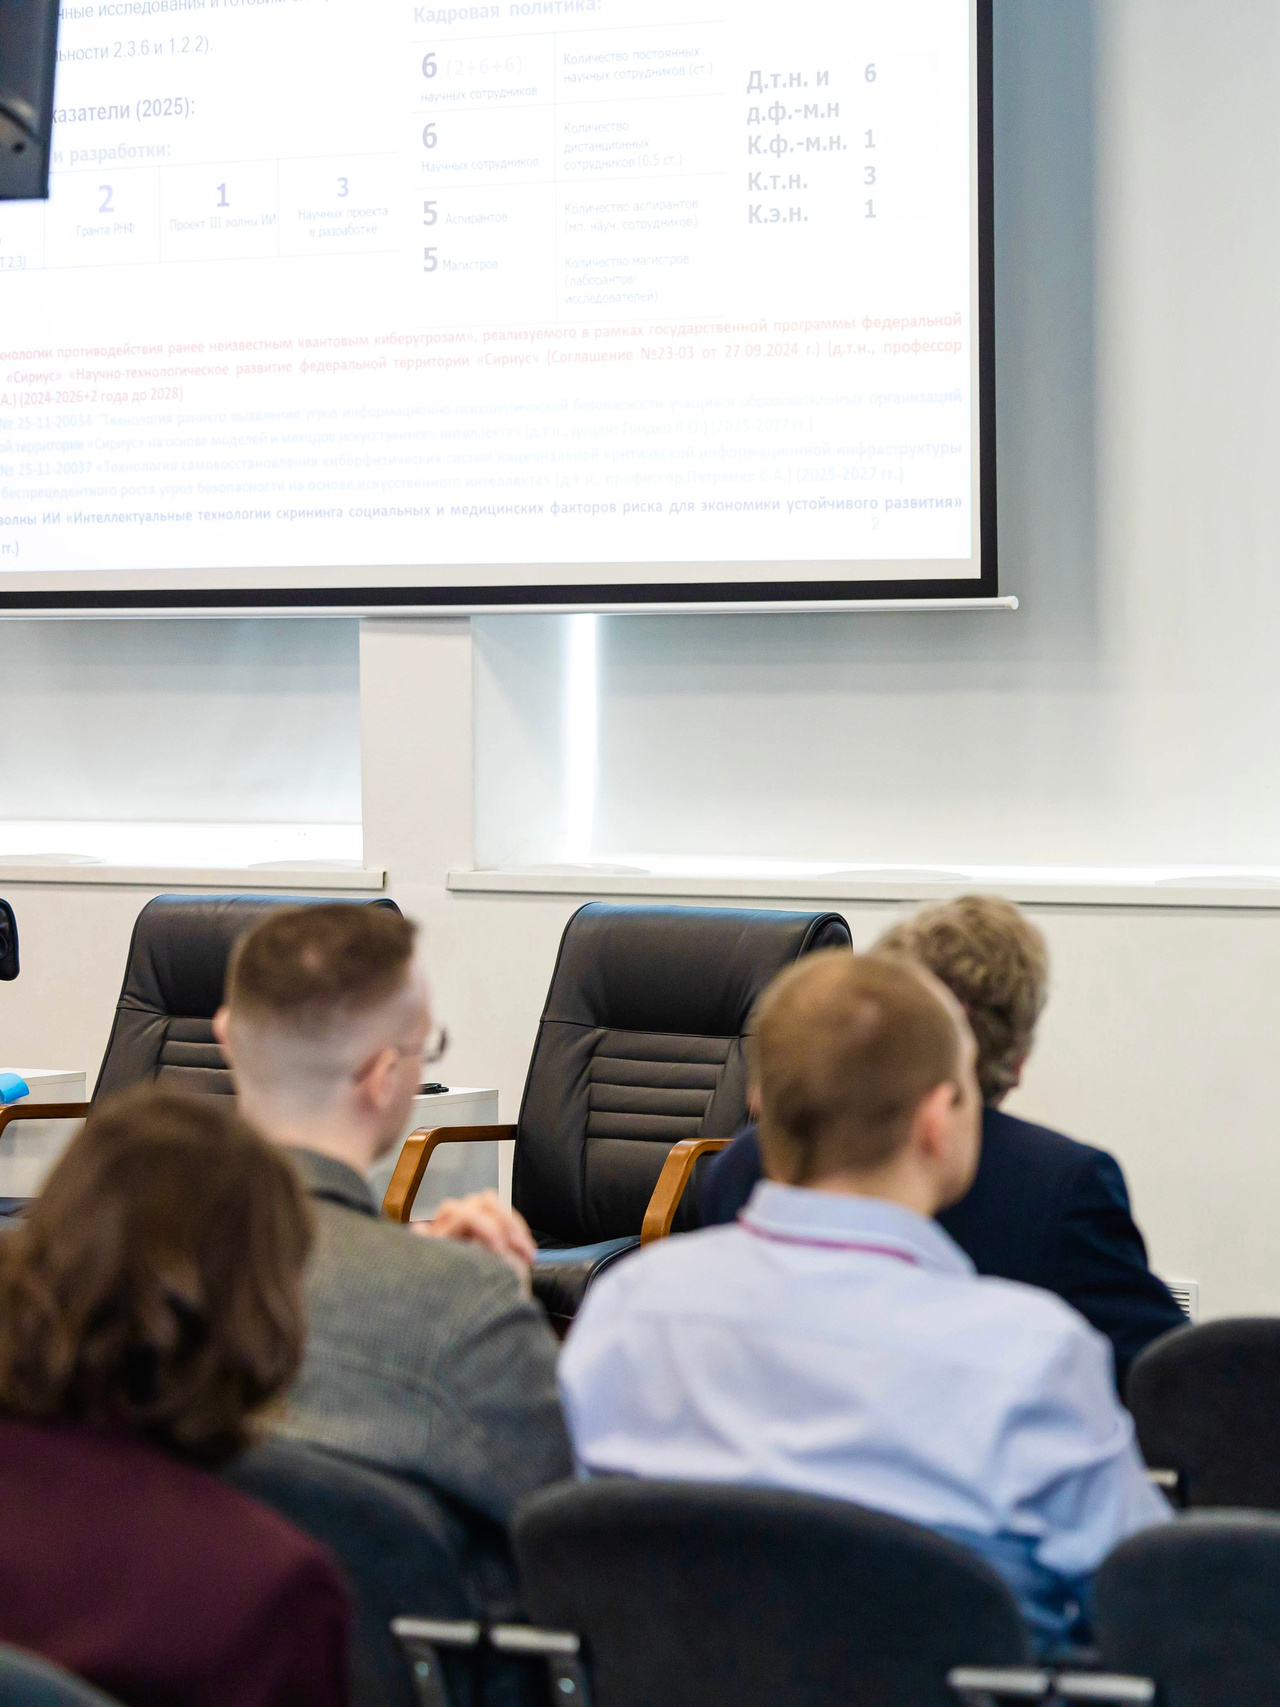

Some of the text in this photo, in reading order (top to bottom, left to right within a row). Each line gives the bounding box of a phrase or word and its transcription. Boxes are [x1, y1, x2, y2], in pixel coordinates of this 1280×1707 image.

[414, 3, 499, 24] Кадровая
[114, 39, 150, 59] 2.3.6
[154, 41, 163, 55] и
[169, 35, 214, 56] 1.2.2).
[421, 52, 437, 79] 6
[864, 63, 877, 83] 6
[747, 70, 829, 94] Д.т.н. и
[136, 97, 196, 122] (2025):
[747, 101, 840, 126] д.ф.-м.н
[421, 123, 438, 149] 6
[748, 133, 848, 158] К.ф.-м.н.
[864, 129, 876, 149] 1
[70, 143, 172, 166] разработки:
[336, 177, 349, 197] 3
[748, 171, 808, 191] К.т.н.
[863, 165, 877, 185] 3
[97, 184, 115, 213] 2
[216, 182, 230, 207] 1
[423, 200, 437, 226] 5
[748, 204, 808, 224] К.э.н.
[864, 199, 877, 218] 1
[423, 246, 438, 273] 5
[57, 311, 962, 359] противодействия ранее неизвестным квантовым киберугрозам», реализуемого рамках государственной программы федеральной
[6, 337, 962, 385] «Сириус» «Научно-технологическое развитие федеральной территории «Сириус» (Соглашение №23-03 от 27.09.2024 г.) (д.т.н., профессор
[19, 385, 184, 408] (2024-2026+2 года до 2028)
[42, 494, 962, 526] ИИ «Интеллектуальные технологии скрининга социальных медицинских факторов риска для экономики устойчивого развития»
